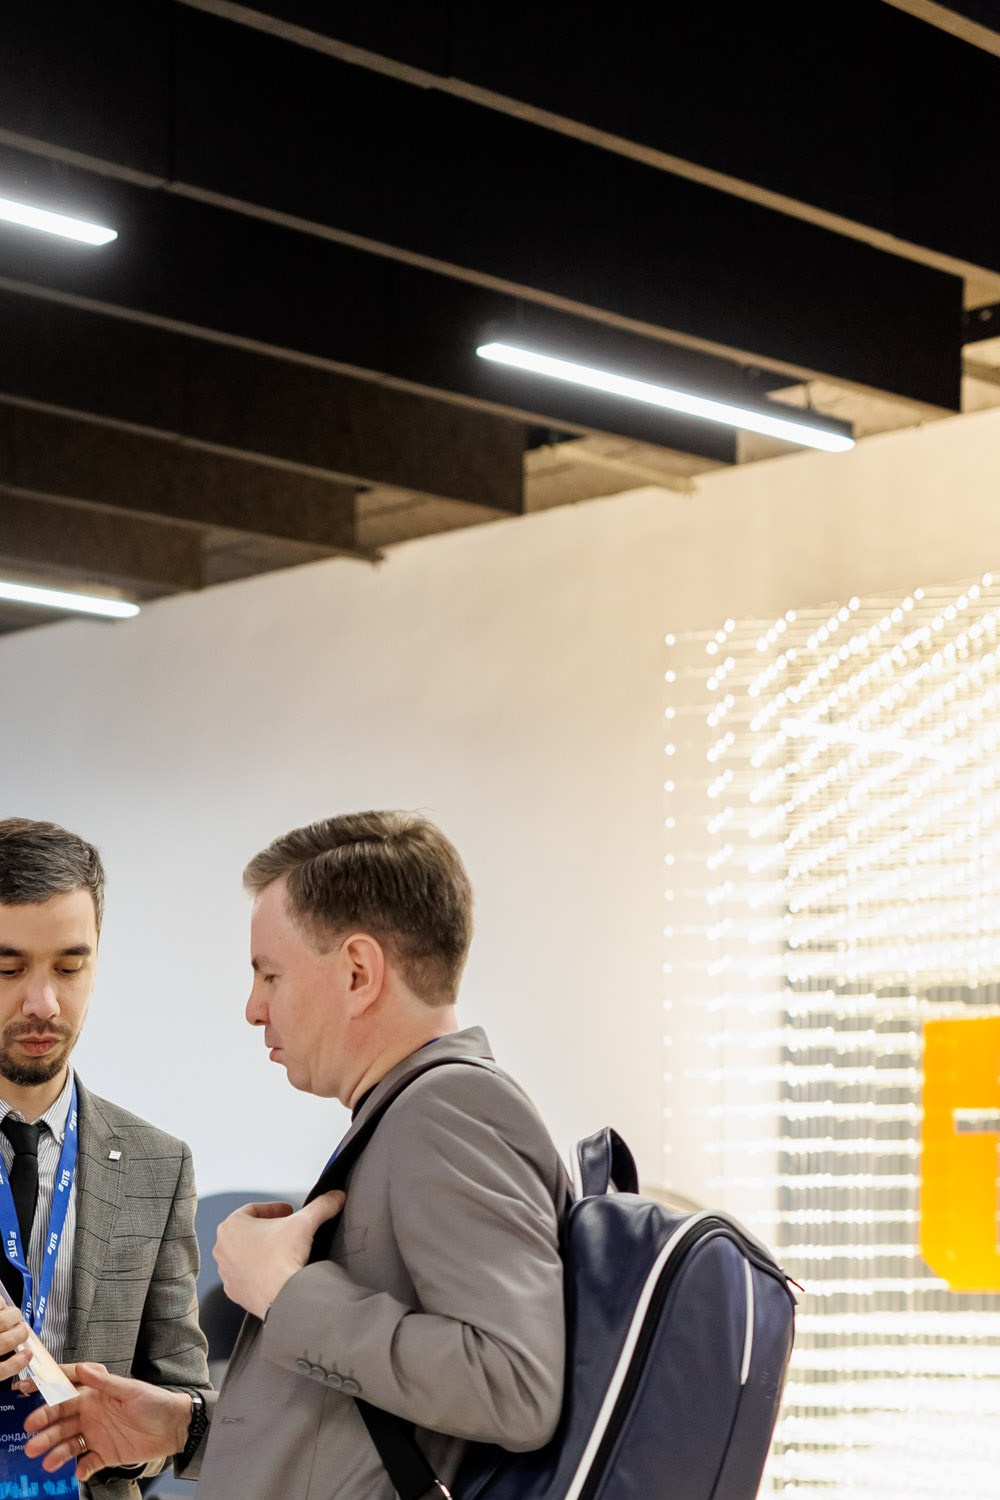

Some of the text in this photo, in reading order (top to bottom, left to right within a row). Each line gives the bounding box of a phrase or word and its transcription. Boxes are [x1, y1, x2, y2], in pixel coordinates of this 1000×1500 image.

[61, 1169, 71, 1187] ВТБ
[7, 1240, 18, 1258] ВТБ
[50, 1232, 58, 1251] ВТБ
